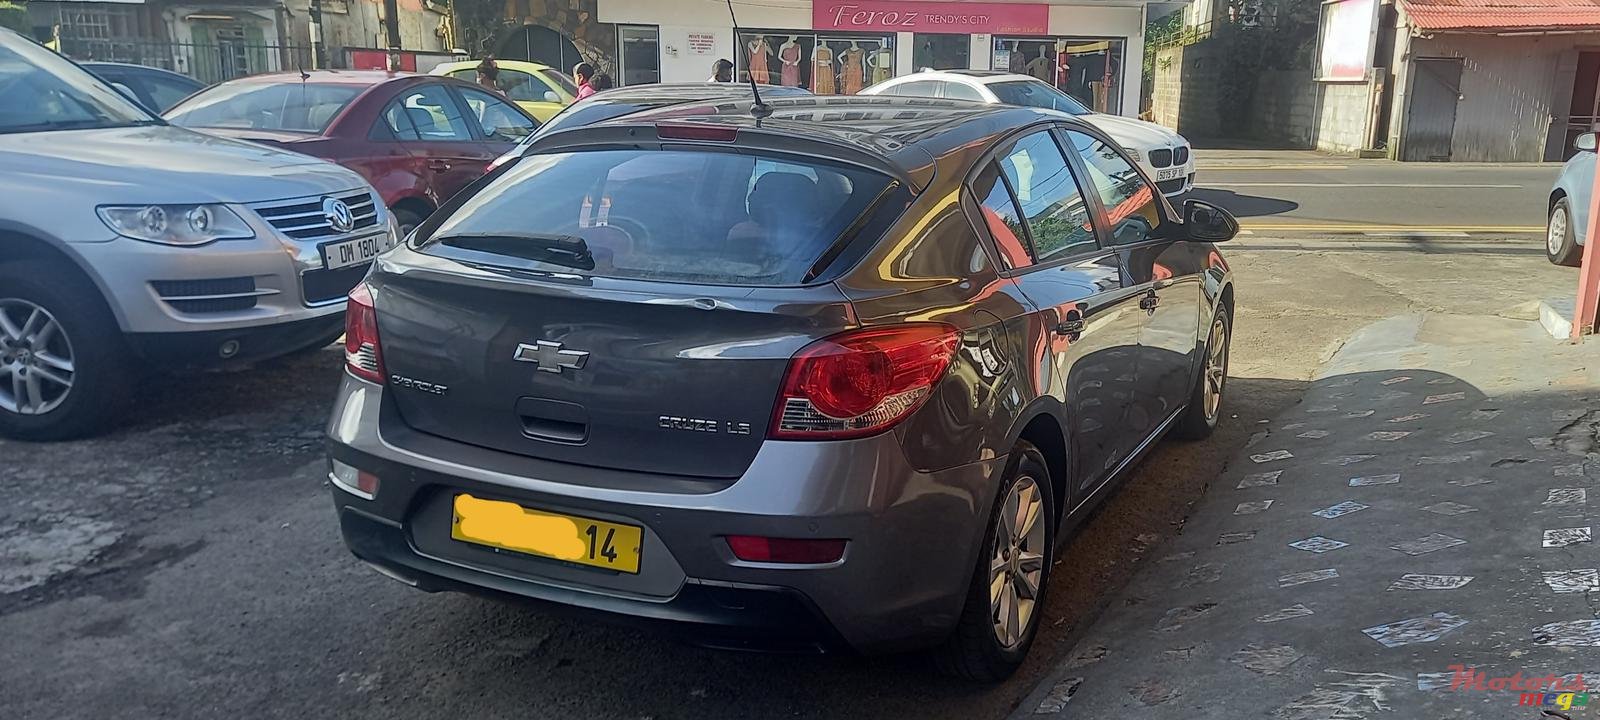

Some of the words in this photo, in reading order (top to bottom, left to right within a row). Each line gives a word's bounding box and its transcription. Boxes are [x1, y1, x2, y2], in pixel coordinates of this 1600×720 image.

[829, 5, 918, 27] Feroz
[924, 14, 967, 25] TRENDY'S
[969, 15, 991, 25] CITY
[340, 243, 355, 263] DM
[358, 238, 380, 259] 1804
[391, 374, 448, 395] CHEVROLET
[659, 415, 718, 433] CRUZE
[726, 421, 751, 435] LS
[585, 524, 618, 563] 14
